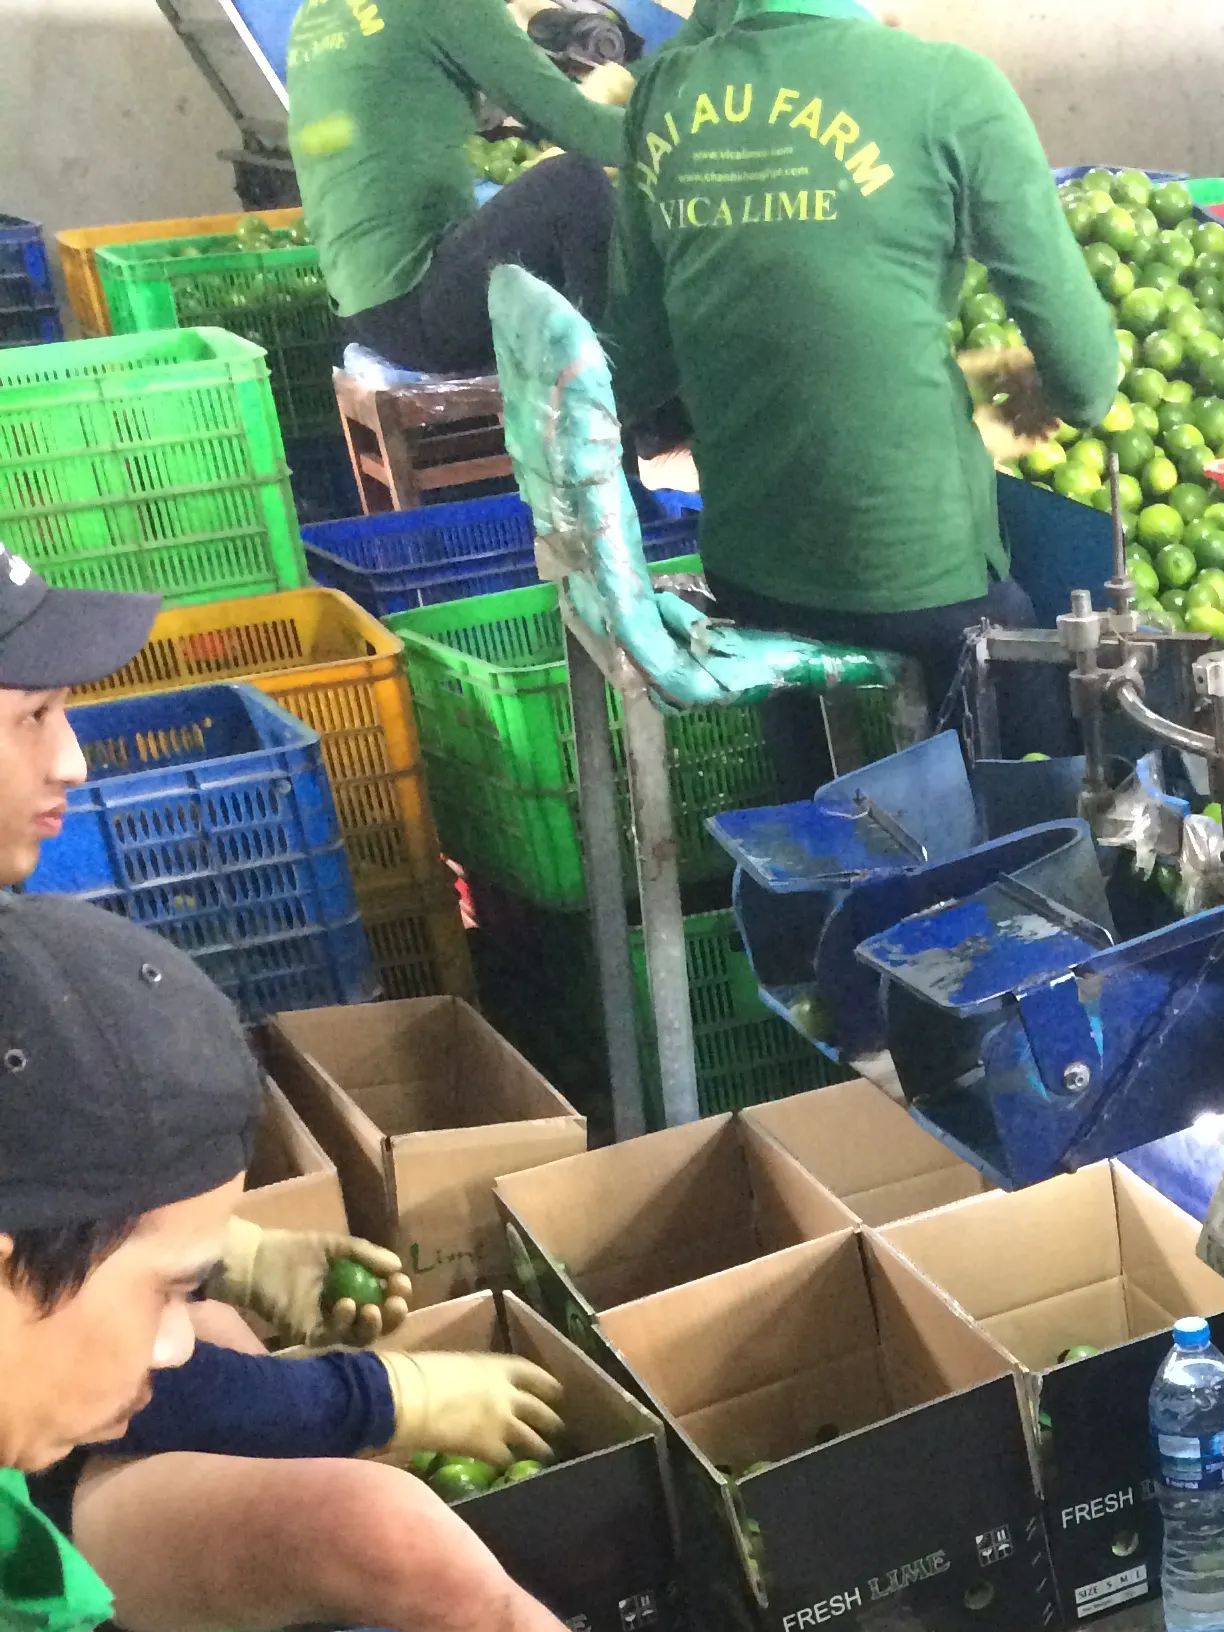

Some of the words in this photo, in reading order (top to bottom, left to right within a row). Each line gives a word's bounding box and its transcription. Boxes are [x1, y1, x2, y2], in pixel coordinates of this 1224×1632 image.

[768, 87, 894, 197] FARM
[1061, 1486, 1134, 1529] FRESH
[868, 1549, 951, 1600] LIME
